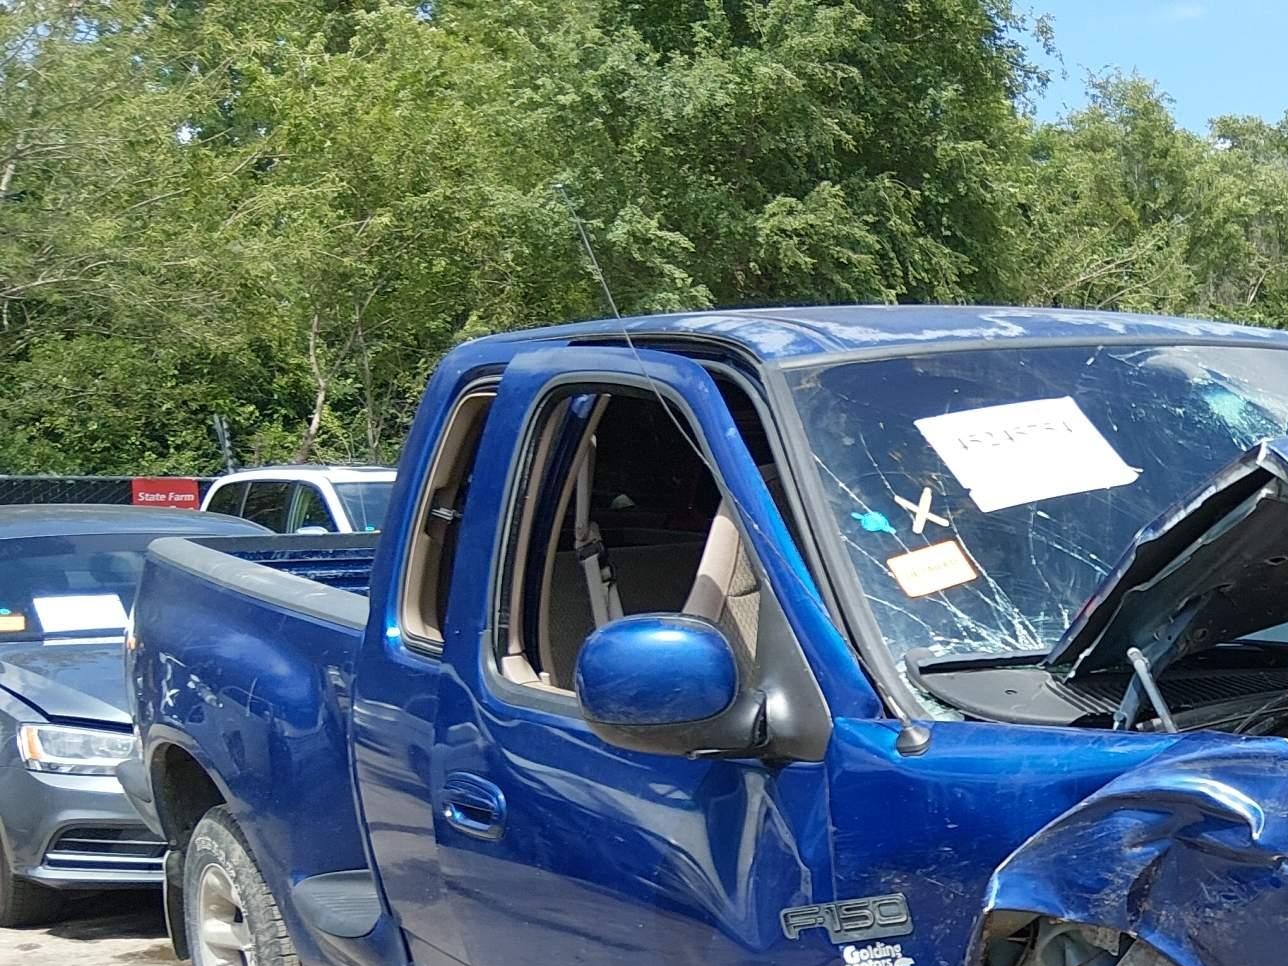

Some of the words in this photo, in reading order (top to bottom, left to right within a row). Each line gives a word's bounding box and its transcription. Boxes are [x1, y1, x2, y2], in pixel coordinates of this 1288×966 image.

[138, 491, 166, 502] State
[167, 491, 194, 502] Farm
[843, 942, 902, 964] Golding
